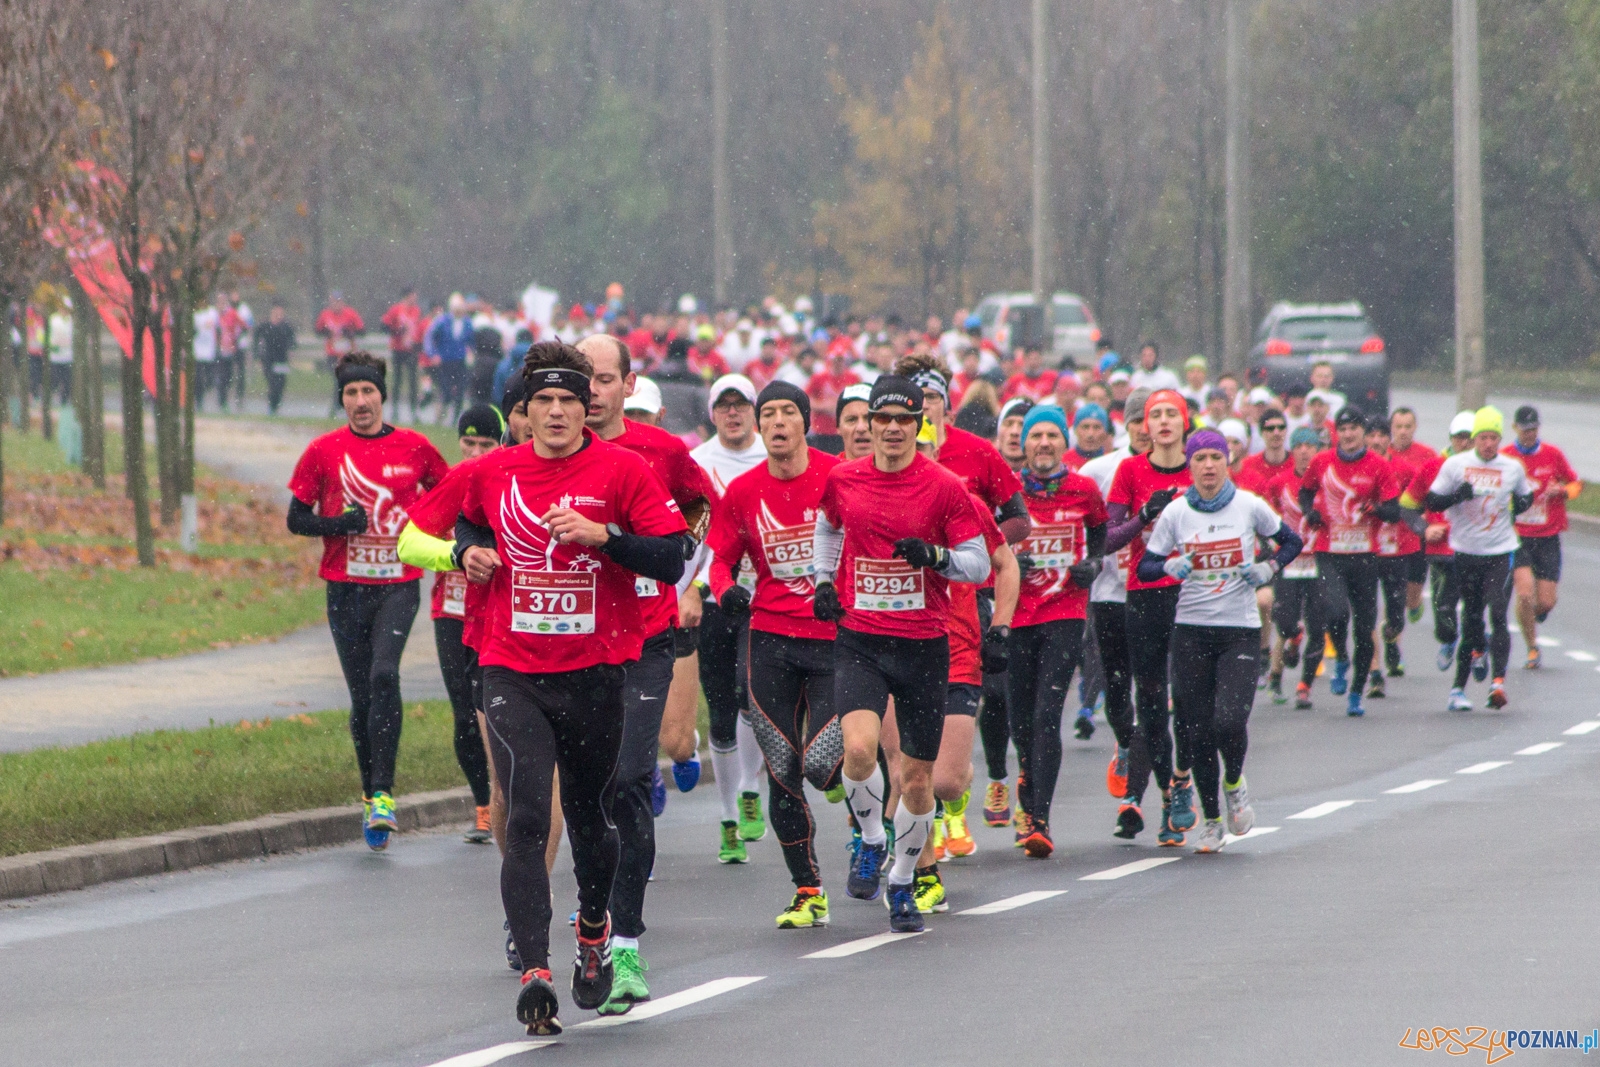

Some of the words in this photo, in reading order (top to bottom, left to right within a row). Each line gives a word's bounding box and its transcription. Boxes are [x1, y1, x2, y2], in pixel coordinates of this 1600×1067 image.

[775, 542, 813, 562] 625
[1030, 539, 1062, 554] 174
[355, 548, 397, 563] 2164
[1199, 552, 1232, 568] 167
[863, 576, 916, 594] 9294
[514, 596, 520, 604] B
[528, 591, 577, 613] 370
